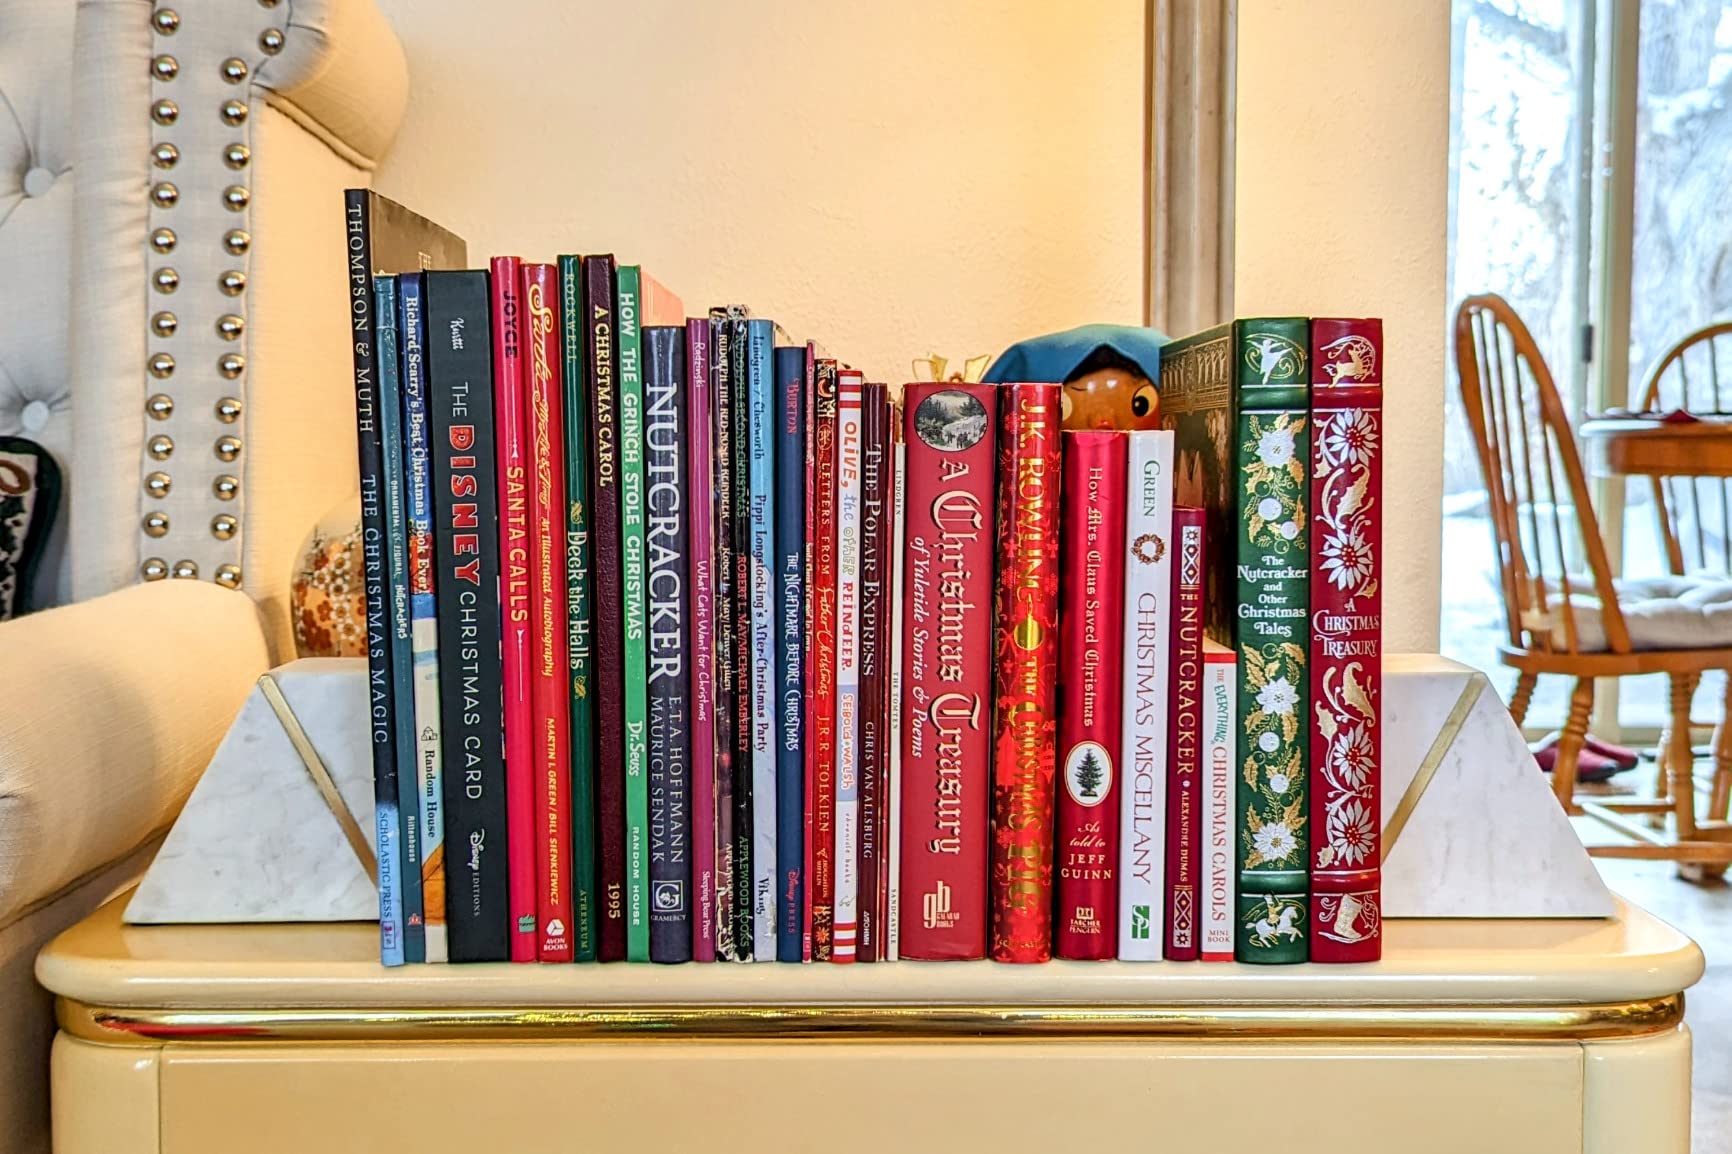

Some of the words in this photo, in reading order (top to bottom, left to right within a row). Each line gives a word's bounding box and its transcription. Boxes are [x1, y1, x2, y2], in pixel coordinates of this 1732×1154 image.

[348, 204, 369, 331] THOMPSON
[405, 297, 421, 350] Richard
[503, 290, 518, 358] JOYCE
[566, 273, 576, 363] ROCKWELL
[594, 305, 609, 319] A
[619, 293, 635, 336] HOW
[355, 342, 369, 357] &
[528, 284, 554, 394] Santa
[718, 334, 730, 382] RUDOLPH
[750, 336, 764, 386] Lindgren
[406, 354, 423, 407] Scarry's
[595, 323, 612, 423] CHRISTMAS
[621, 348, 637, 382] THE
[693, 342, 706, 387] Radzinski
[357, 368, 374, 433] MUTH
[452, 382, 469, 417] THE
[719, 386, 729, 405] THE
[786, 378, 800, 434] BURTON
[410, 413, 424, 442] Best
[623, 393, 639, 462] GRINCH
[719, 408, 731, 464] RED-NOSED
[736, 402, 747, 450] SECOND
[752, 402, 766, 460] Chesworth
[1019, 399, 1047, 448] J.K.
[598, 427, 613, 487] CAROL
[864, 444, 882, 490] THE
[938, 458, 970, 483] A
[362, 475, 378, 517] THE
[412, 447, 428, 515] Christmas
[506, 466, 526, 540] SANTA
[624, 472, 640, 525] STOLE
[720, 469, 731, 519] REINDEER
[736, 452, 748, 518] CHRISTMAS
[821, 463, 832, 525] LETTERS
[1088, 467, 1103, 502] How
[1142, 460, 1161, 518] GREEN
[449, 425, 480, 586] DISNEY
[540, 517, 551, 531] An
[751, 495, 767, 525] Pippi
[843, 494, 858, 521] the
[1086, 506, 1102, 546] Mrs.
[415, 520, 428, 552] Book
[645, 382, 681, 684] NUTCRACKER
[863, 500, 882, 571] POLAR
[910, 537, 931, 559] of
[1015, 458, 1045, 601] ROWLING
[417, 558, 430, 594] Ever!
[540, 534, 553, 593] Illustrated
[567, 531, 587, 580] Deck
[696, 560, 708, 590] What
[721, 547, 732, 579] Robert
[736, 555, 748, 601] ROBERT
[752, 531, 768, 617] Longstocking's
[787, 553, 799, 572] THE
[821, 537, 832, 575] FROM
[1086, 551, 1102, 594] Claus
[1237, 565, 1308, 582] Nutcracker
[1261, 556, 1285, 565] The
[365, 528, 386, 658] CHRISTMAS
[509, 548, 528, 622] CALLS
[568, 585, 585, 613] the
[625, 535, 643, 640] CHRISTMAS
[696, 595, 710, 617] Cats
[784, 575, 802, 640] NIGHTMARE
[912, 559, 931, 623] Yuletide
[930, 490, 984, 683] Christmas
[1258, 594, 1288, 603] Other
[1263, 582, 1282, 591] and
[1344, 598, 1356, 612] A
[395, 585, 409, 639] NUTCRACKERS
[817, 586, 834, 632] Father
[862, 581, 881, 676] EXPRESS
[1085, 600, 1100, 644] Saved
[1238, 603, 1306, 618] Christmas
[1253, 621, 1292, 637] Tales
[1313, 610, 1380, 636] CHRISTMAS
[459, 591, 480, 725] CHRISTMAS
[541, 596, 556, 677] Autobiography
[568, 621, 589, 669] Halls
[697, 621, 709, 650] Want
[912, 627, 930, 680] Stories
[1314, 635, 1377, 659] TREASURY
[697, 654, 710, 668] for
[755, 623, 769, 718] After-Christmas
[785, 643, 800, 686] BEFORE
[818, 630, 834, 700] Christmas
[1018, 656, 1040, 697] THE
[1136, 593, 1158, 726] CHRISTMAS
[372, 670, 388, 742] MAGIC
[697, 672, 711, 721] Christmas
[912, 686, 930, 704] &
[1081, 649, 1100, 727] Christmas
[1177, 606, 1198, 775] NUTCRACKER
[547, 718, 556, 759] MARTIN
[627, 721, 643, 740] Dr.
[651, 694, 665, 780] MAURICE
[738, 695, 749, 752] EMBERLEY
[753, 723, 769, 753] Party
[784, 690, 802, 751] CHRISTMAS
[864, 721, 875, 760] CHRIS
[911, 707, 929, 758] Poems
[425, 750, 437, 796] Random
[464, 735, 482, 799] CARD
[627, 743, 645, 776] Seuss
[864, 765, 874, 790] VAN
[926, 692, 982, 855] Treasury
[1008, 702, 1044, 830] CHRISTMAS
[547, 770, 557, 805] GREEN
[670, 747, 684, 863] HOFFMANN
[819, 763, 831, 831] TOLKIEN
[1133, 736, 1154, 885] MISCELLANY
[1211, 746, 1228, 846] CHRISTMAS
[407, 816, 417, 862] Rittenhouse
[426, 801, 438, 837] House
[549, 813, 558, 834] BILL
[652, 787, 666, 863] SENDAK
[863, 795, 874, 858] ALLSBURG
[1069, 835, 1096, 847] told
[1077, 820, 1100, 832] As
[1180, 790, 1190, 846] ALEXANDRE
[379, 812, 391, 882] SCHOLASTIC
[467, 829, 485, 871] Disney
[631, 827, 640, 878] RANDOM
[739, 836, 749, 905] APPLEWOOD
[1068, 853, 1105, 865] JEFF
[1179, 850, 1189, 882] DUMAS
[471, 872, 481, 918] EDITIONS
[549, 838, 559, 905] SIENKIEWICZ
[700, 871, 710, 901] Sleeping
[786, 868, 800, 901] Disney
[1007, 841, 1041, 909] PIG
[1061, 867, 1112, 879] GUINN
[1211, 851, 1227, 921] CAROLS
[382, 885, 392, 917] PRESS
[579, 889, 588, 948] ATHENEUM
[607, 883, 621, 919] 1995
[632, 885, 640, 925] HOUSE
[701, 903, 710, 918] Bear
[755, 877, 769, 914] Viking
[788, 902, 796, 933] PRESS
[702, 920, 711, 938] Press
[740, 909, 750, 947] BOOKS
